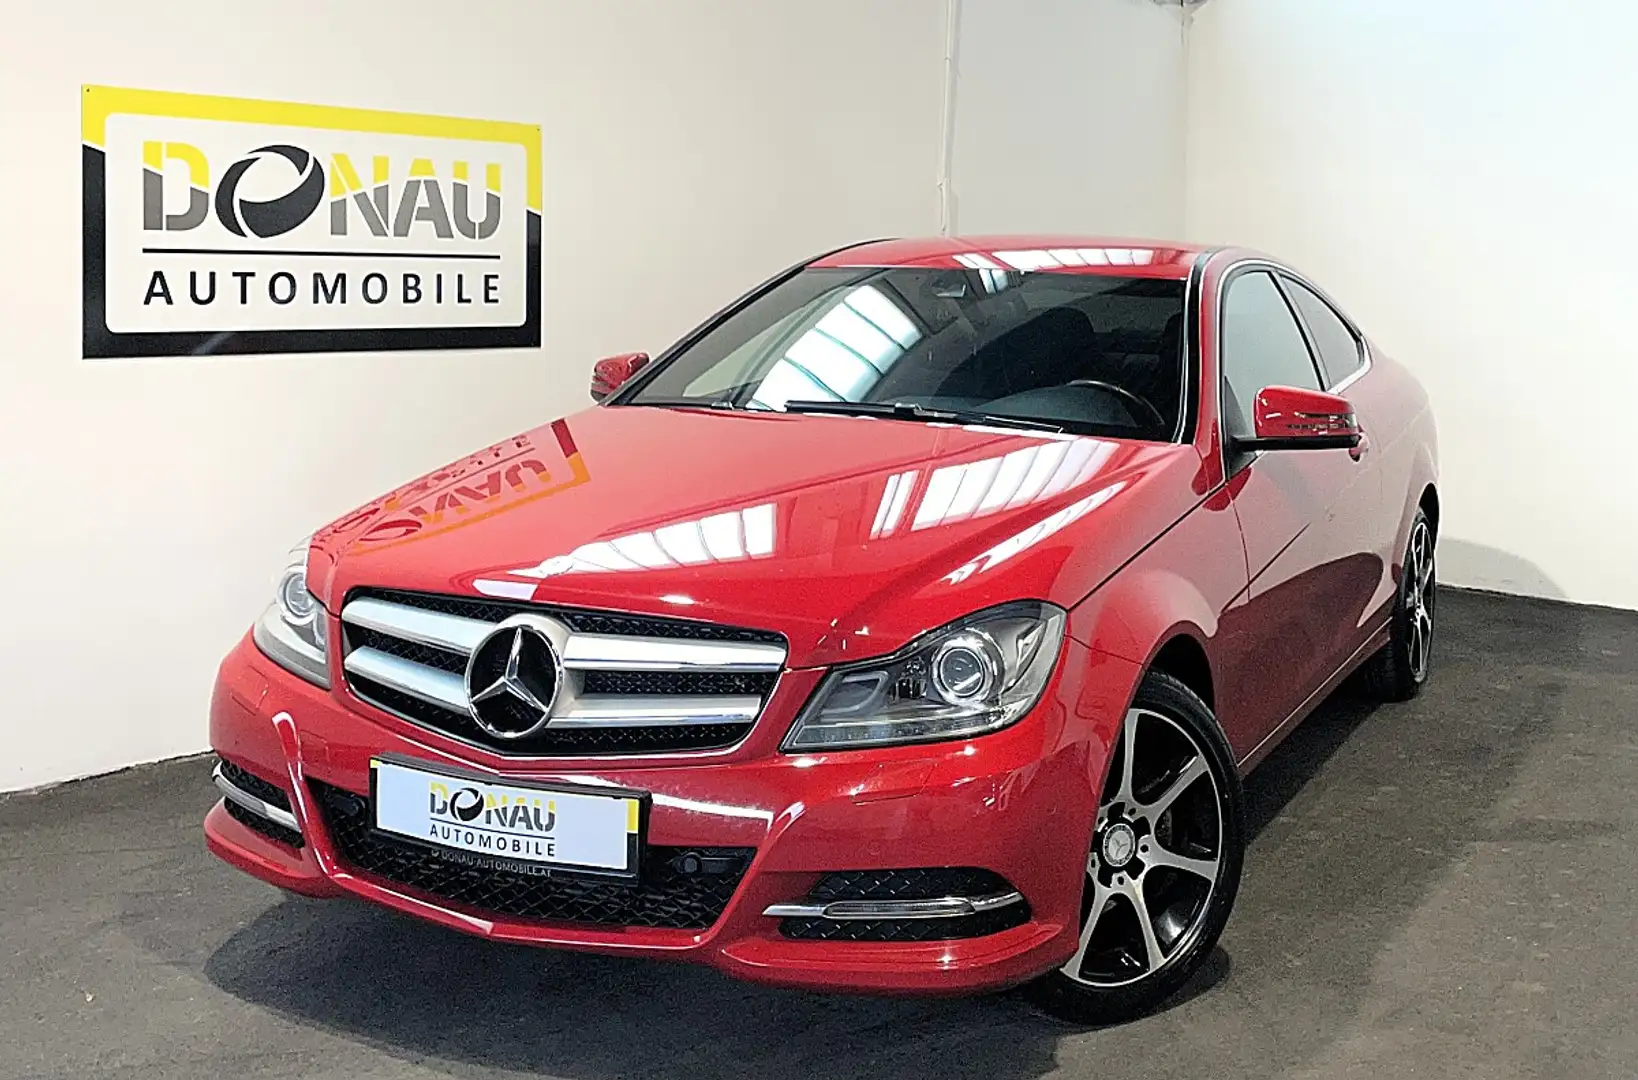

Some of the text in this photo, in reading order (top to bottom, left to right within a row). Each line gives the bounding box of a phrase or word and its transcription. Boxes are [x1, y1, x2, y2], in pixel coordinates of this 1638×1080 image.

[143, 141, 501, 239] DONAU
[143, 270, 501, 306] AUTOMOBILE
[430, 781, 556, 832] DONAU
[430, 824, 556, 857] AUTOMOBILE
